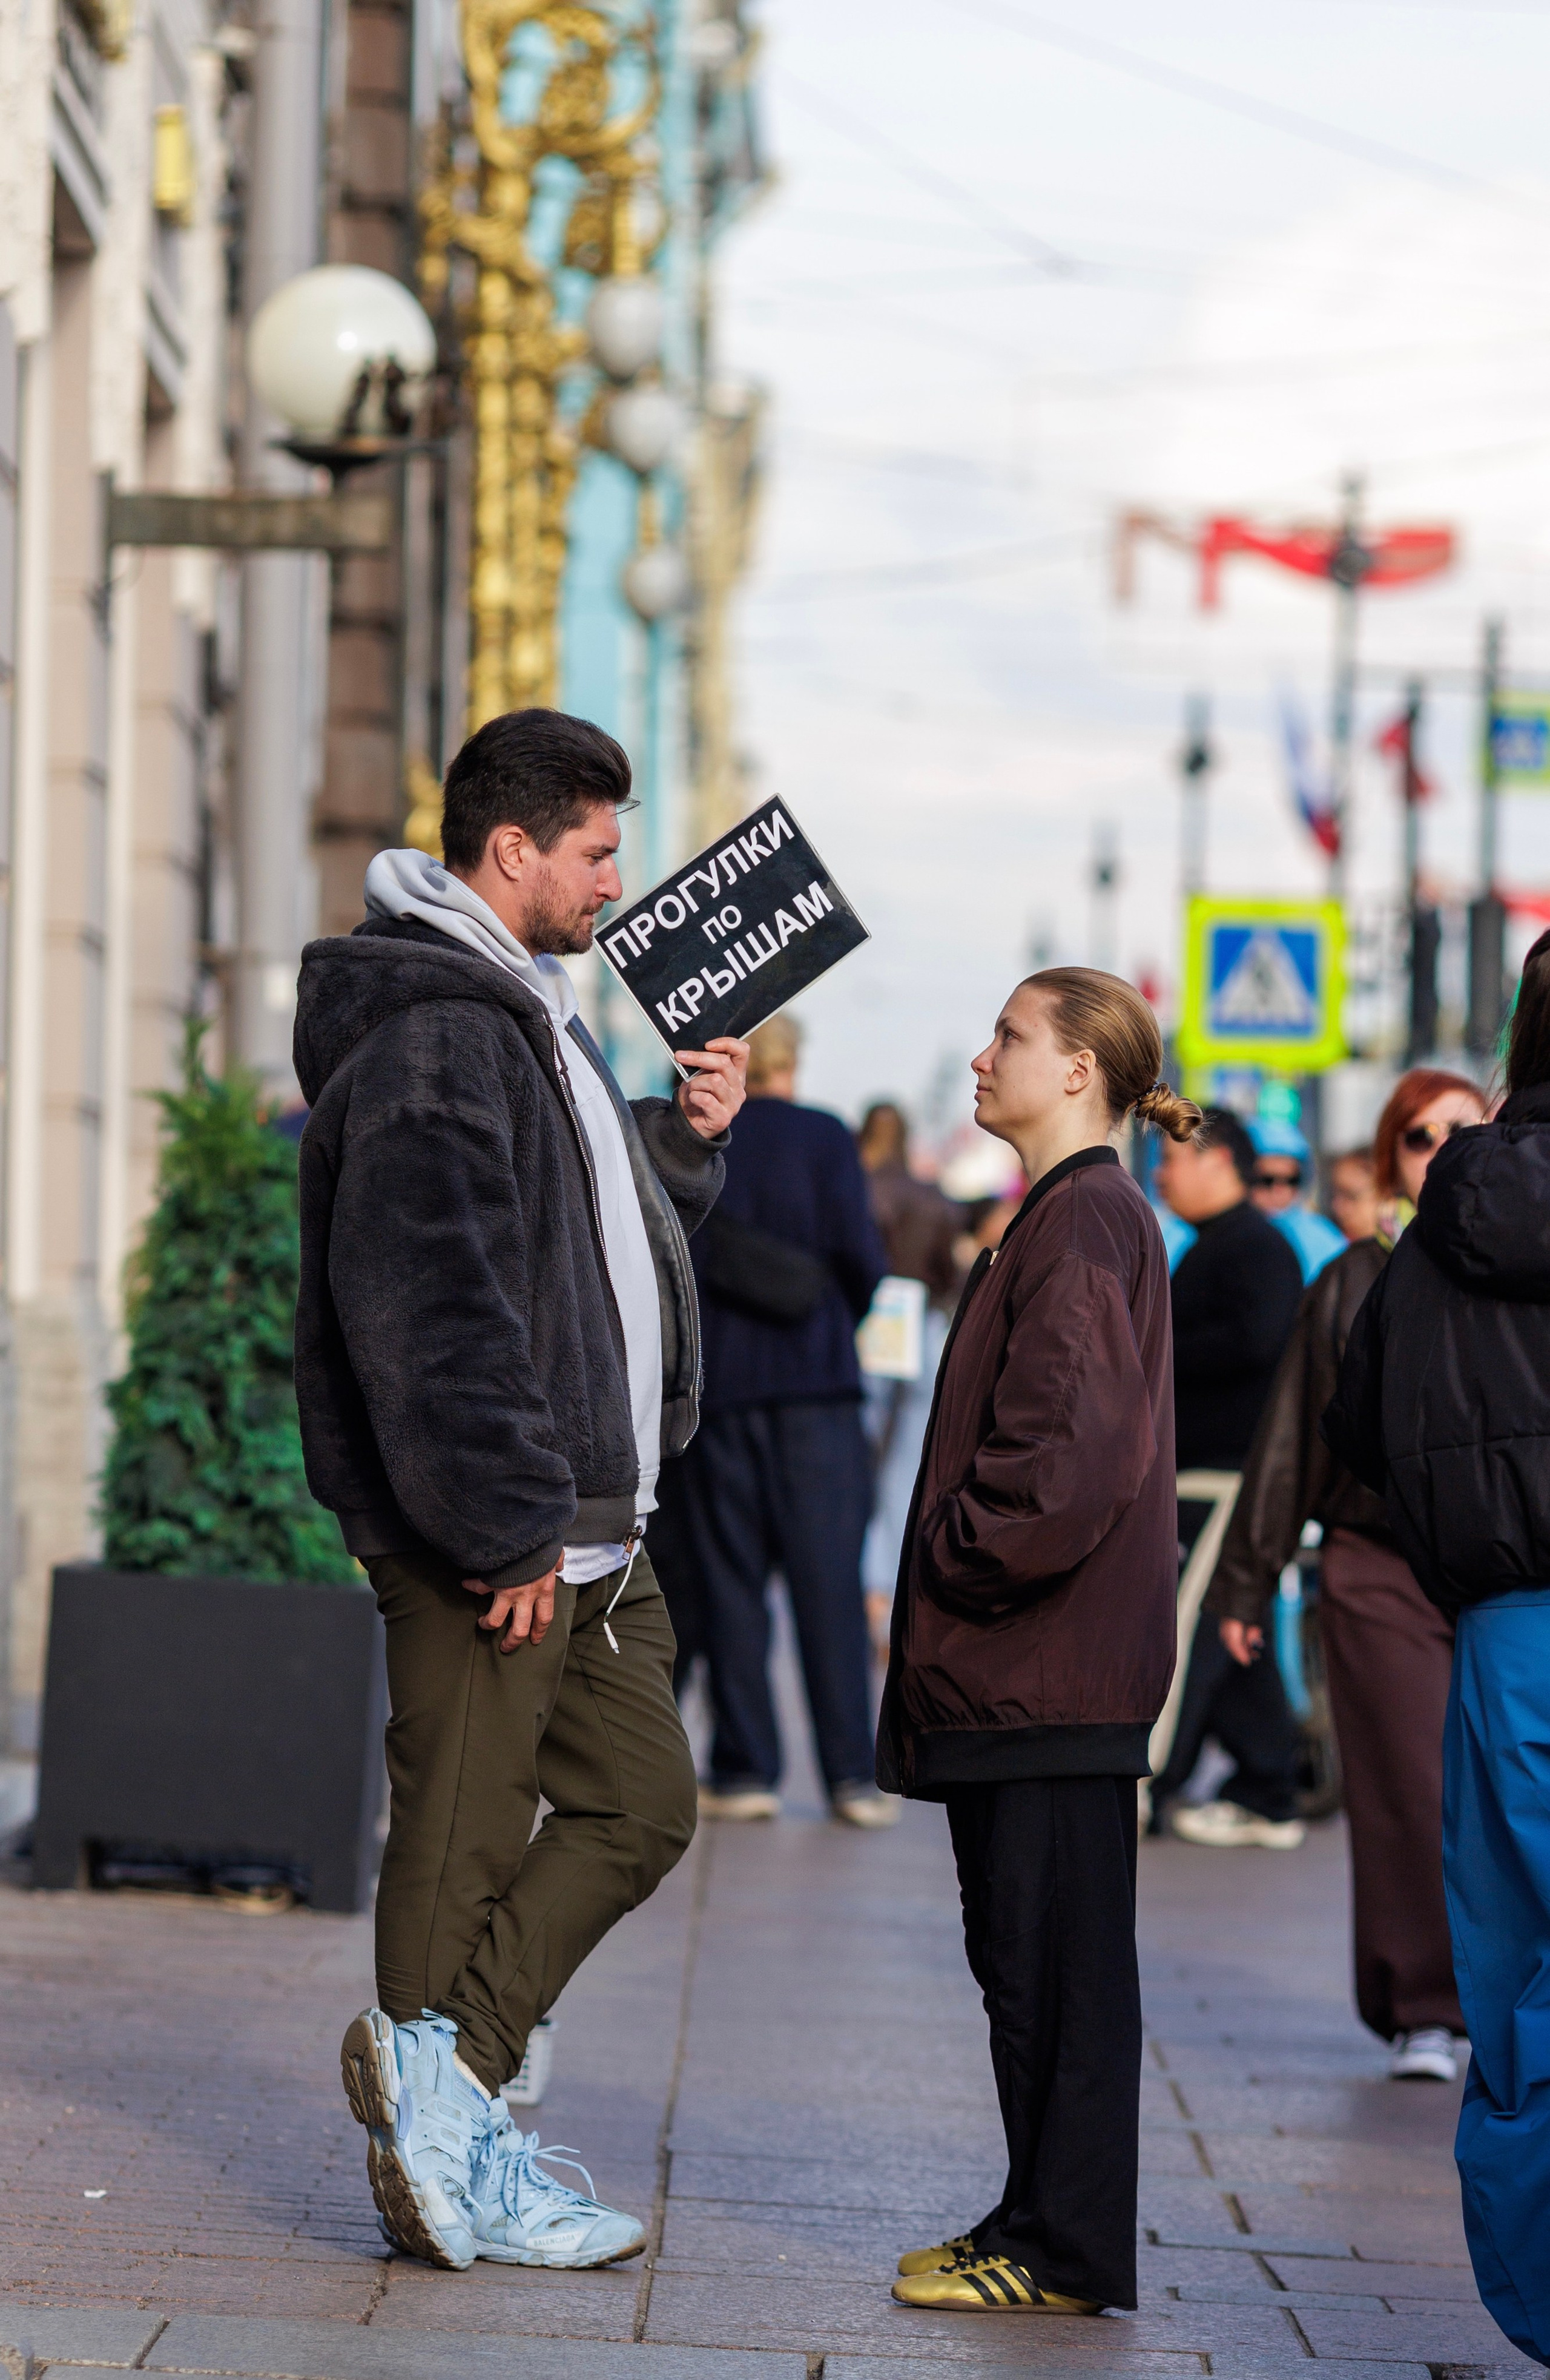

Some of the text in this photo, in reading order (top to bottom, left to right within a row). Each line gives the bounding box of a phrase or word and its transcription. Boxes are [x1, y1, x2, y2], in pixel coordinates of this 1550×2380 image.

[604, 809, 795, 969] ПРОГУЛКИ
[701, 905, 742, 944] ПО
[655, 880, 834, 1033] КРЫШАМ
[533, 2234, 575, 2247] BALENCIAGA
